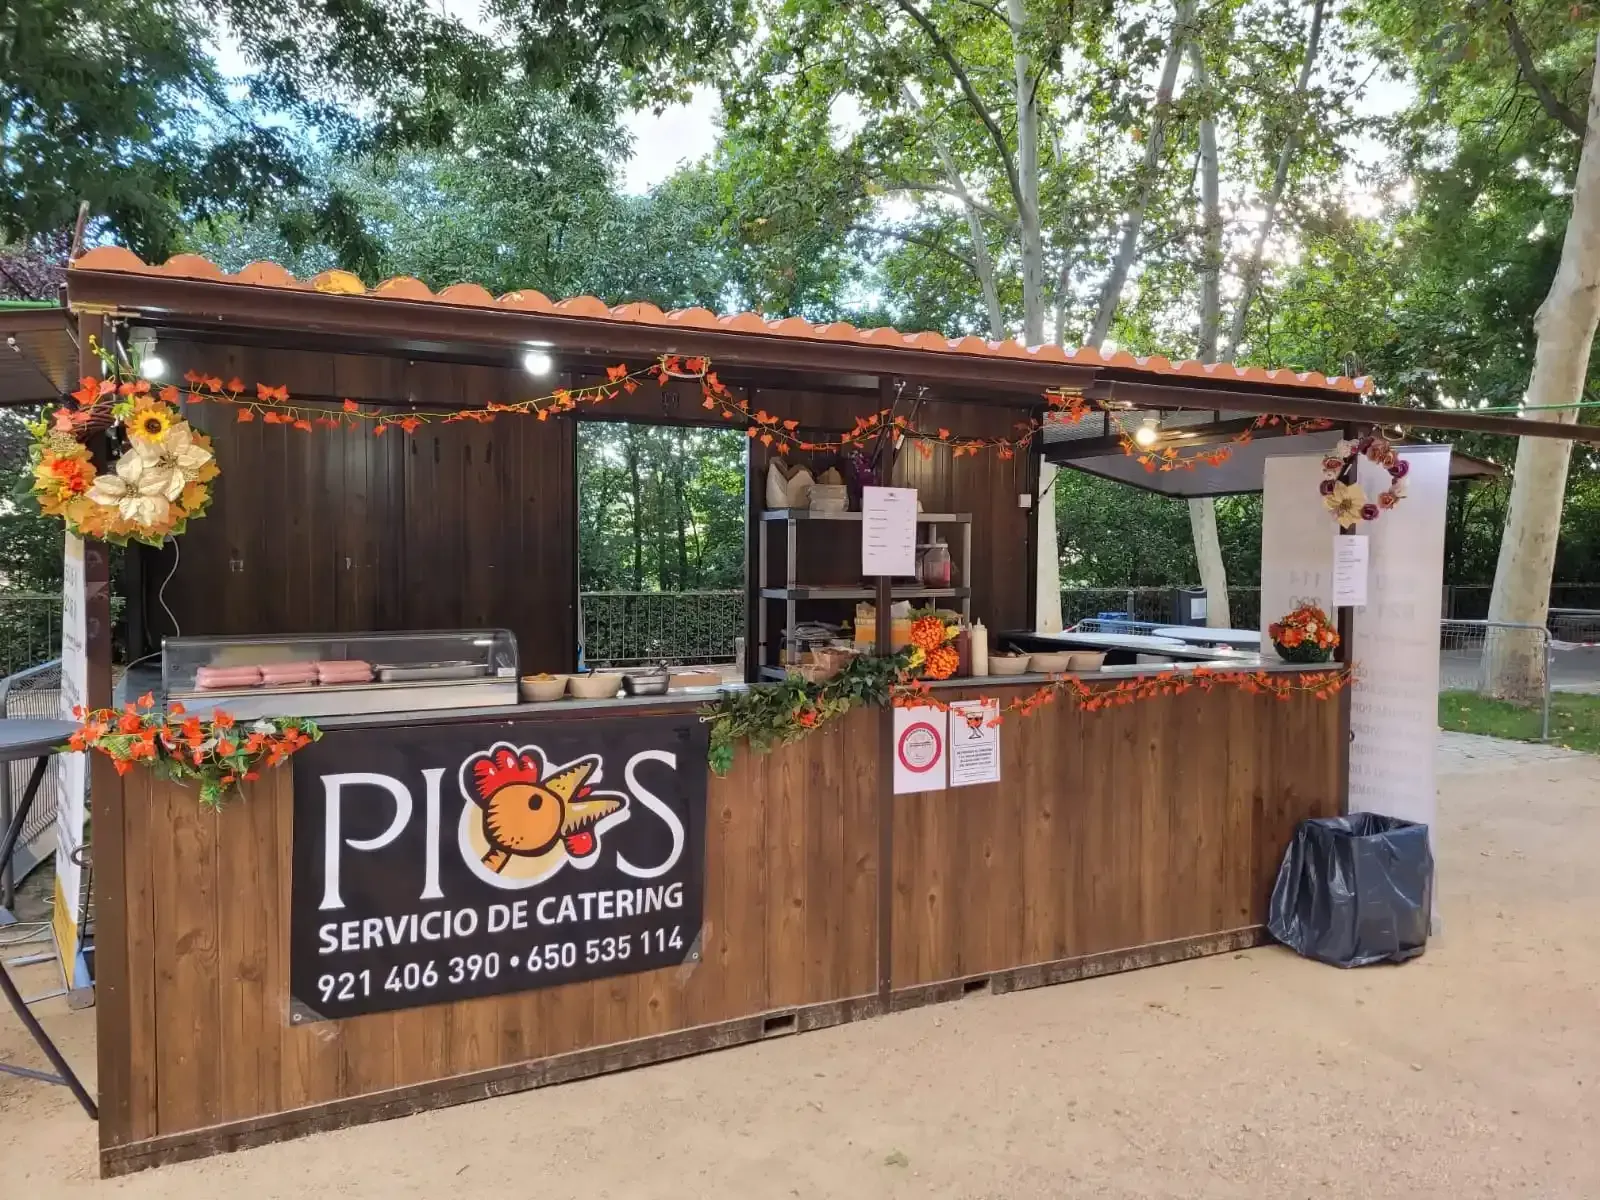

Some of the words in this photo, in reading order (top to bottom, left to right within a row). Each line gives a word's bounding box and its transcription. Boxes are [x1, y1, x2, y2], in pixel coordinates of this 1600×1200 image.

[318, 907, 478, 954] SERVICIO
[488, 900, 528, 933] DE
[536, 882, 683, 926] CATERING
[318, 969, 370, 1003] 921
[384, 961, 439, 992] 406
[448, 952, 500, 984] 390
[527, 941, 577, 972] 650
[585, 934, 632, 964] 535
[640, 926, 684, 955] 114
